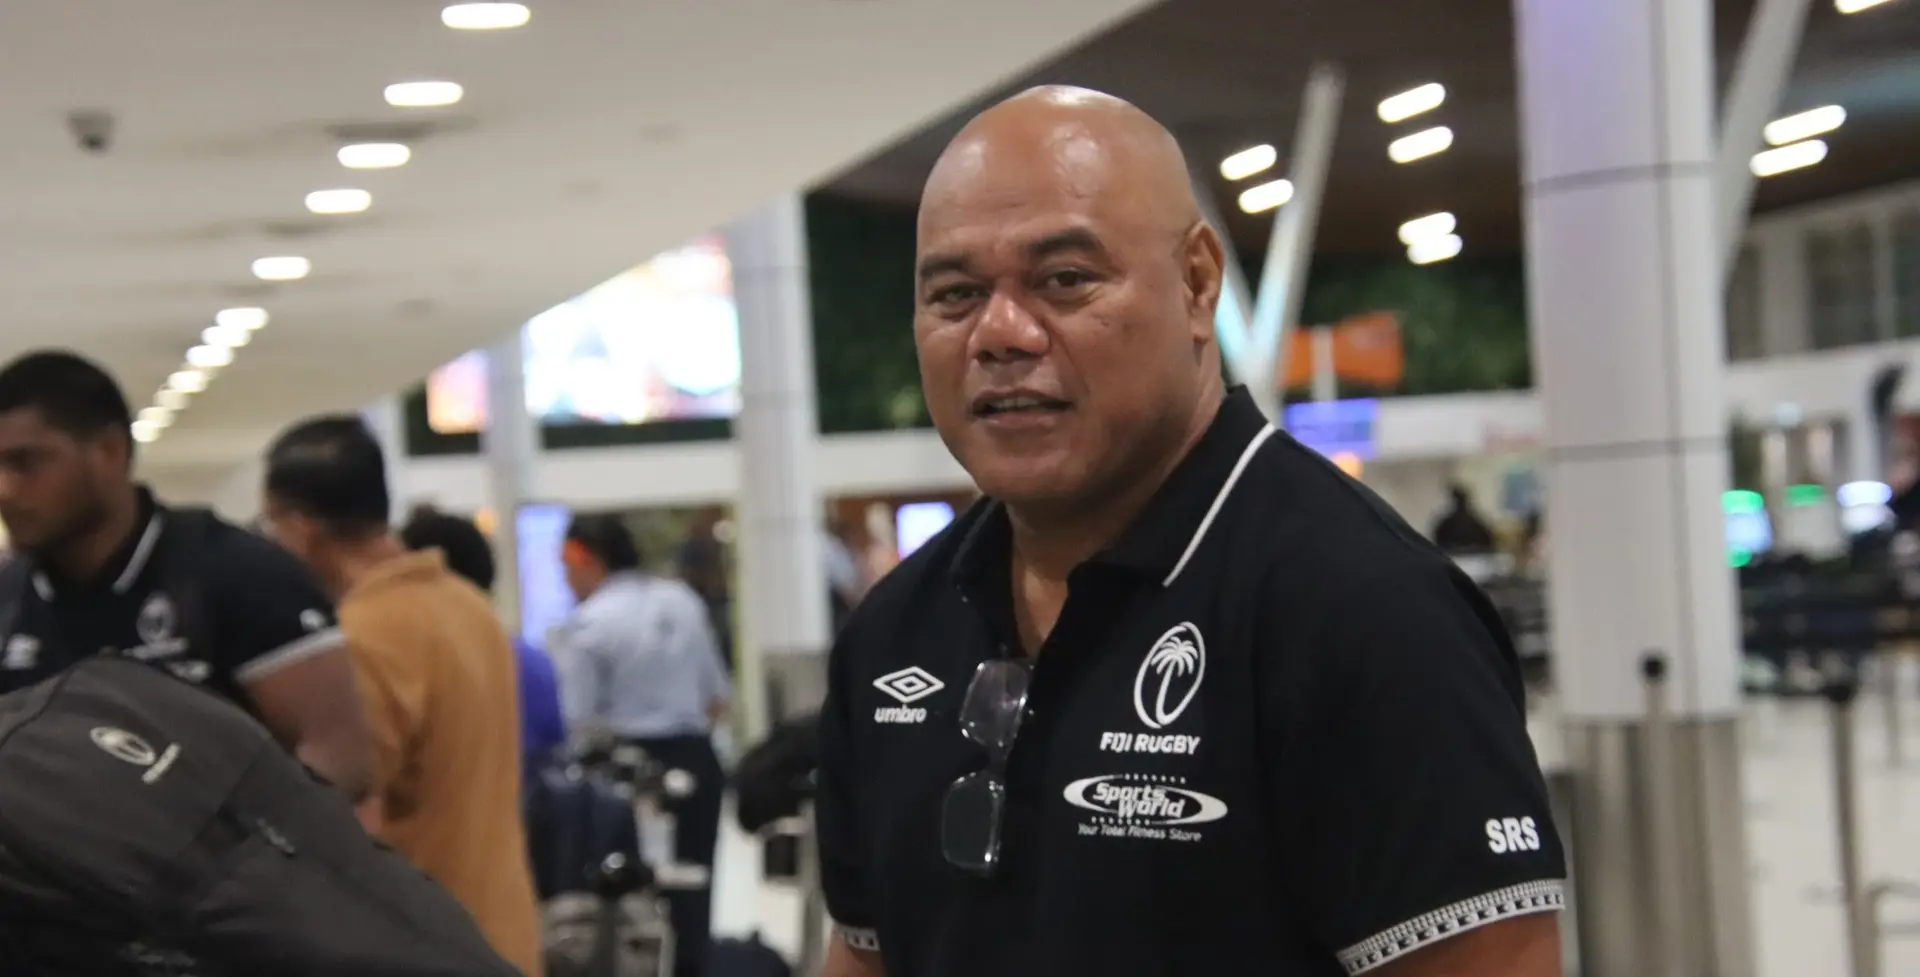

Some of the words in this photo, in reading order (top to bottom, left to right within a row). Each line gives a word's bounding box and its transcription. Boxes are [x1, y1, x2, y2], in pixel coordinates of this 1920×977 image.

[874, 703, 927, 724] umbro
[1100, 732, 1133, 753] FIJI
[1134, 733, 1201, 755] RUGBY
[1092, 782, 1167, 806] Sports
[1116, 797, 1187, 819] World
[1077, 822, 1100, 836] Your
[1100, 823, 1127, 837] Total
[1127, 825, 1167, 840] Fitness
[1169, 827, 1203, 842] Store
[1485, 816, 1540, 854] SRS
